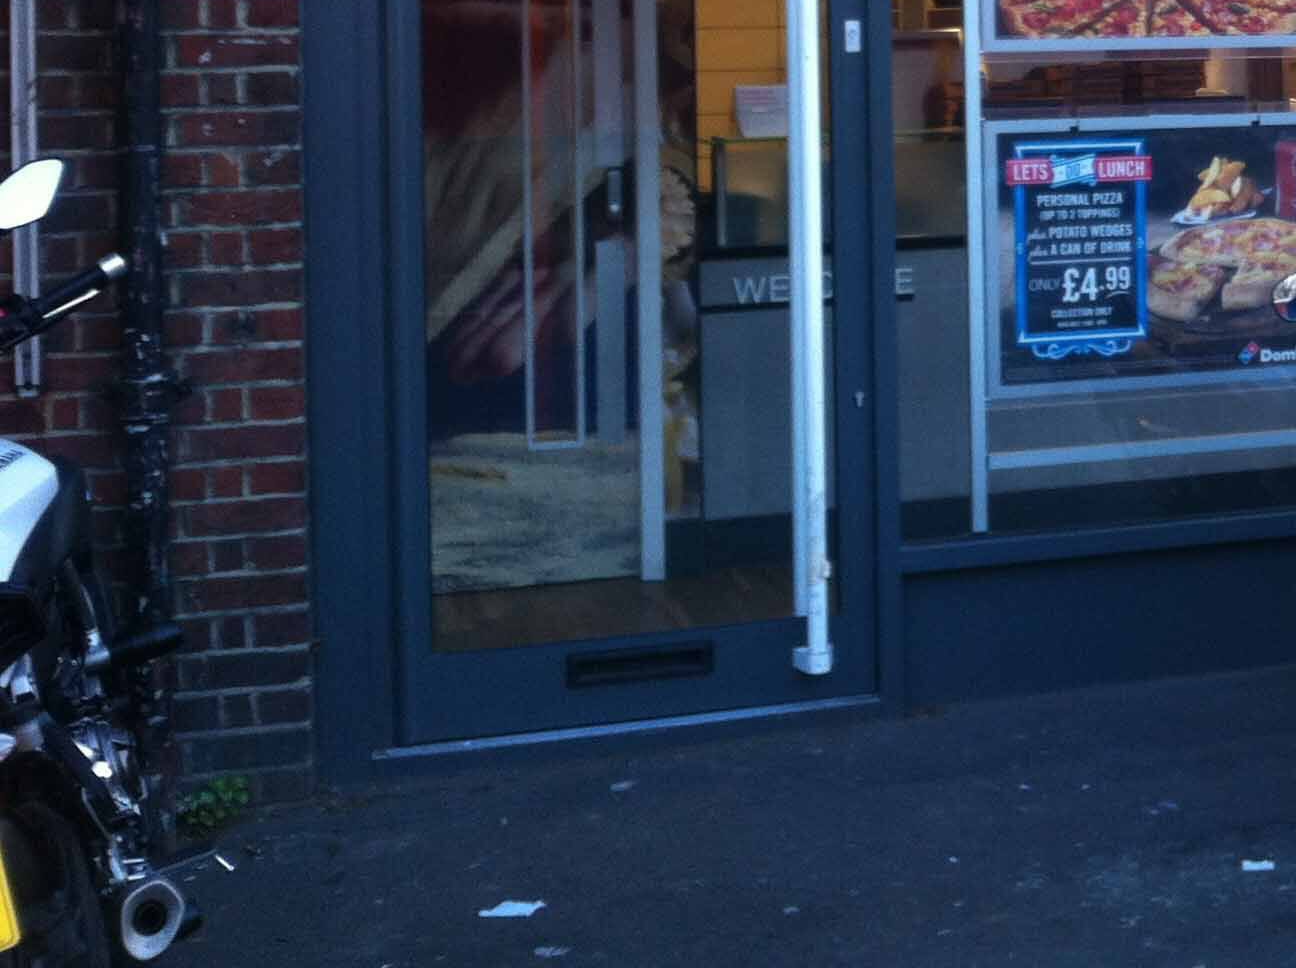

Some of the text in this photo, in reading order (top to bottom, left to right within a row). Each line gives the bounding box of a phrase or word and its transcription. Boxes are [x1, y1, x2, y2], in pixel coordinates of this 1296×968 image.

[1013, 164, 1049, 181] LETS
[1098, 160, 1146, 178] LUNCH
[1036, 192, 1124, 207] PERSONAL PIZZA
[1048, 226, 1088, 239] POTATO
[1090, 224, 1134, 238] WEDGES
[1050, 243, 1058, 256] A
[1059, 242, 1081, 255] CAN
[1084, 242, 1097, 254] OF
[1062, 266, 1131, 303] £4.99
